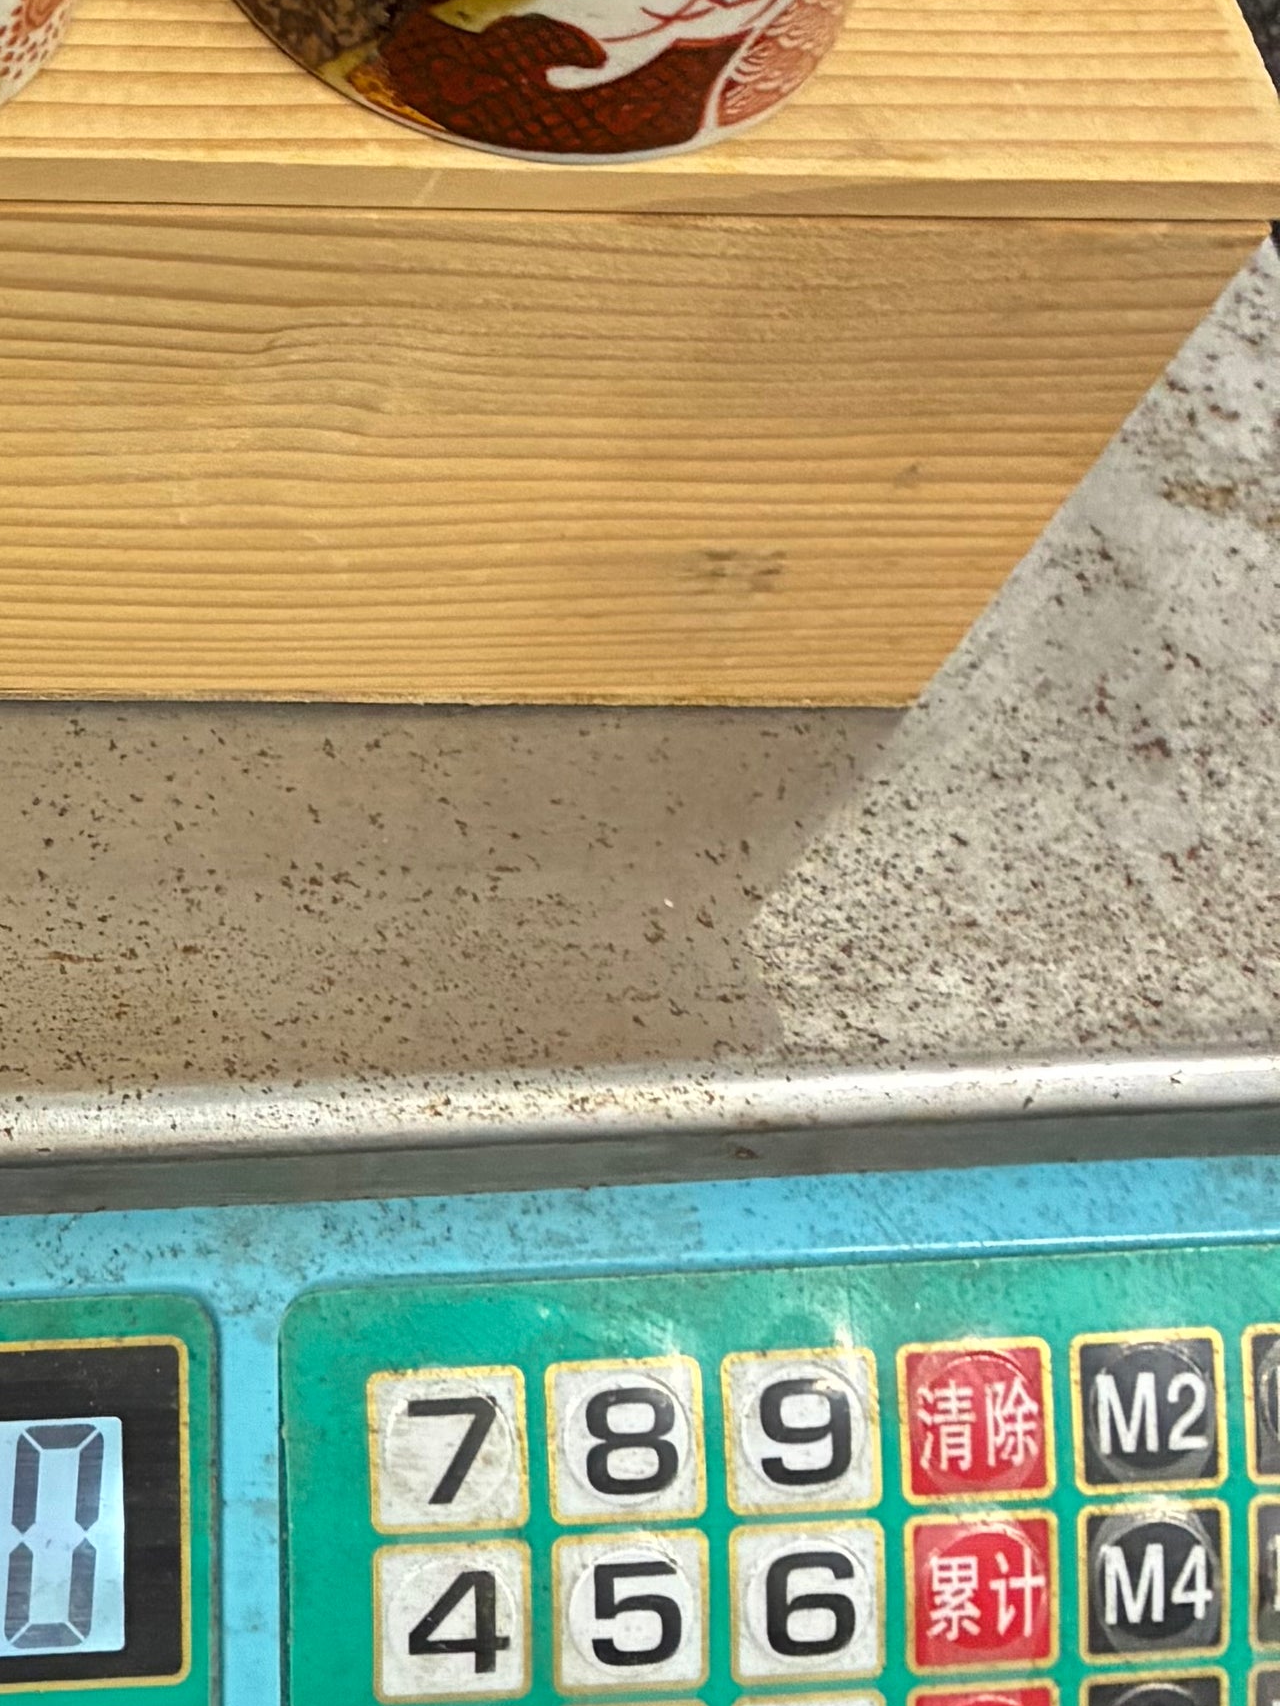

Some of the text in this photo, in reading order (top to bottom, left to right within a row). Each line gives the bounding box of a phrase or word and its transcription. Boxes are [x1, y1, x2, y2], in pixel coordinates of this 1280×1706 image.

[407, 1396, 498, 1506] 7
[584, 1386, 681, 1496] 8
[757, 1378, 853, 1487] 9
[917, 1380, 1041, 1473] 清除
[1095, 1370, 1208, 1454] M2
[407, 1569, 510, 1674] 4
[591, 1560, 684, 1667] 5
[763, 1551, 856, 1657] 6
[926, 1552, 1045, 1643] 累计
[1104, 1543, 1213, 1624] M4
